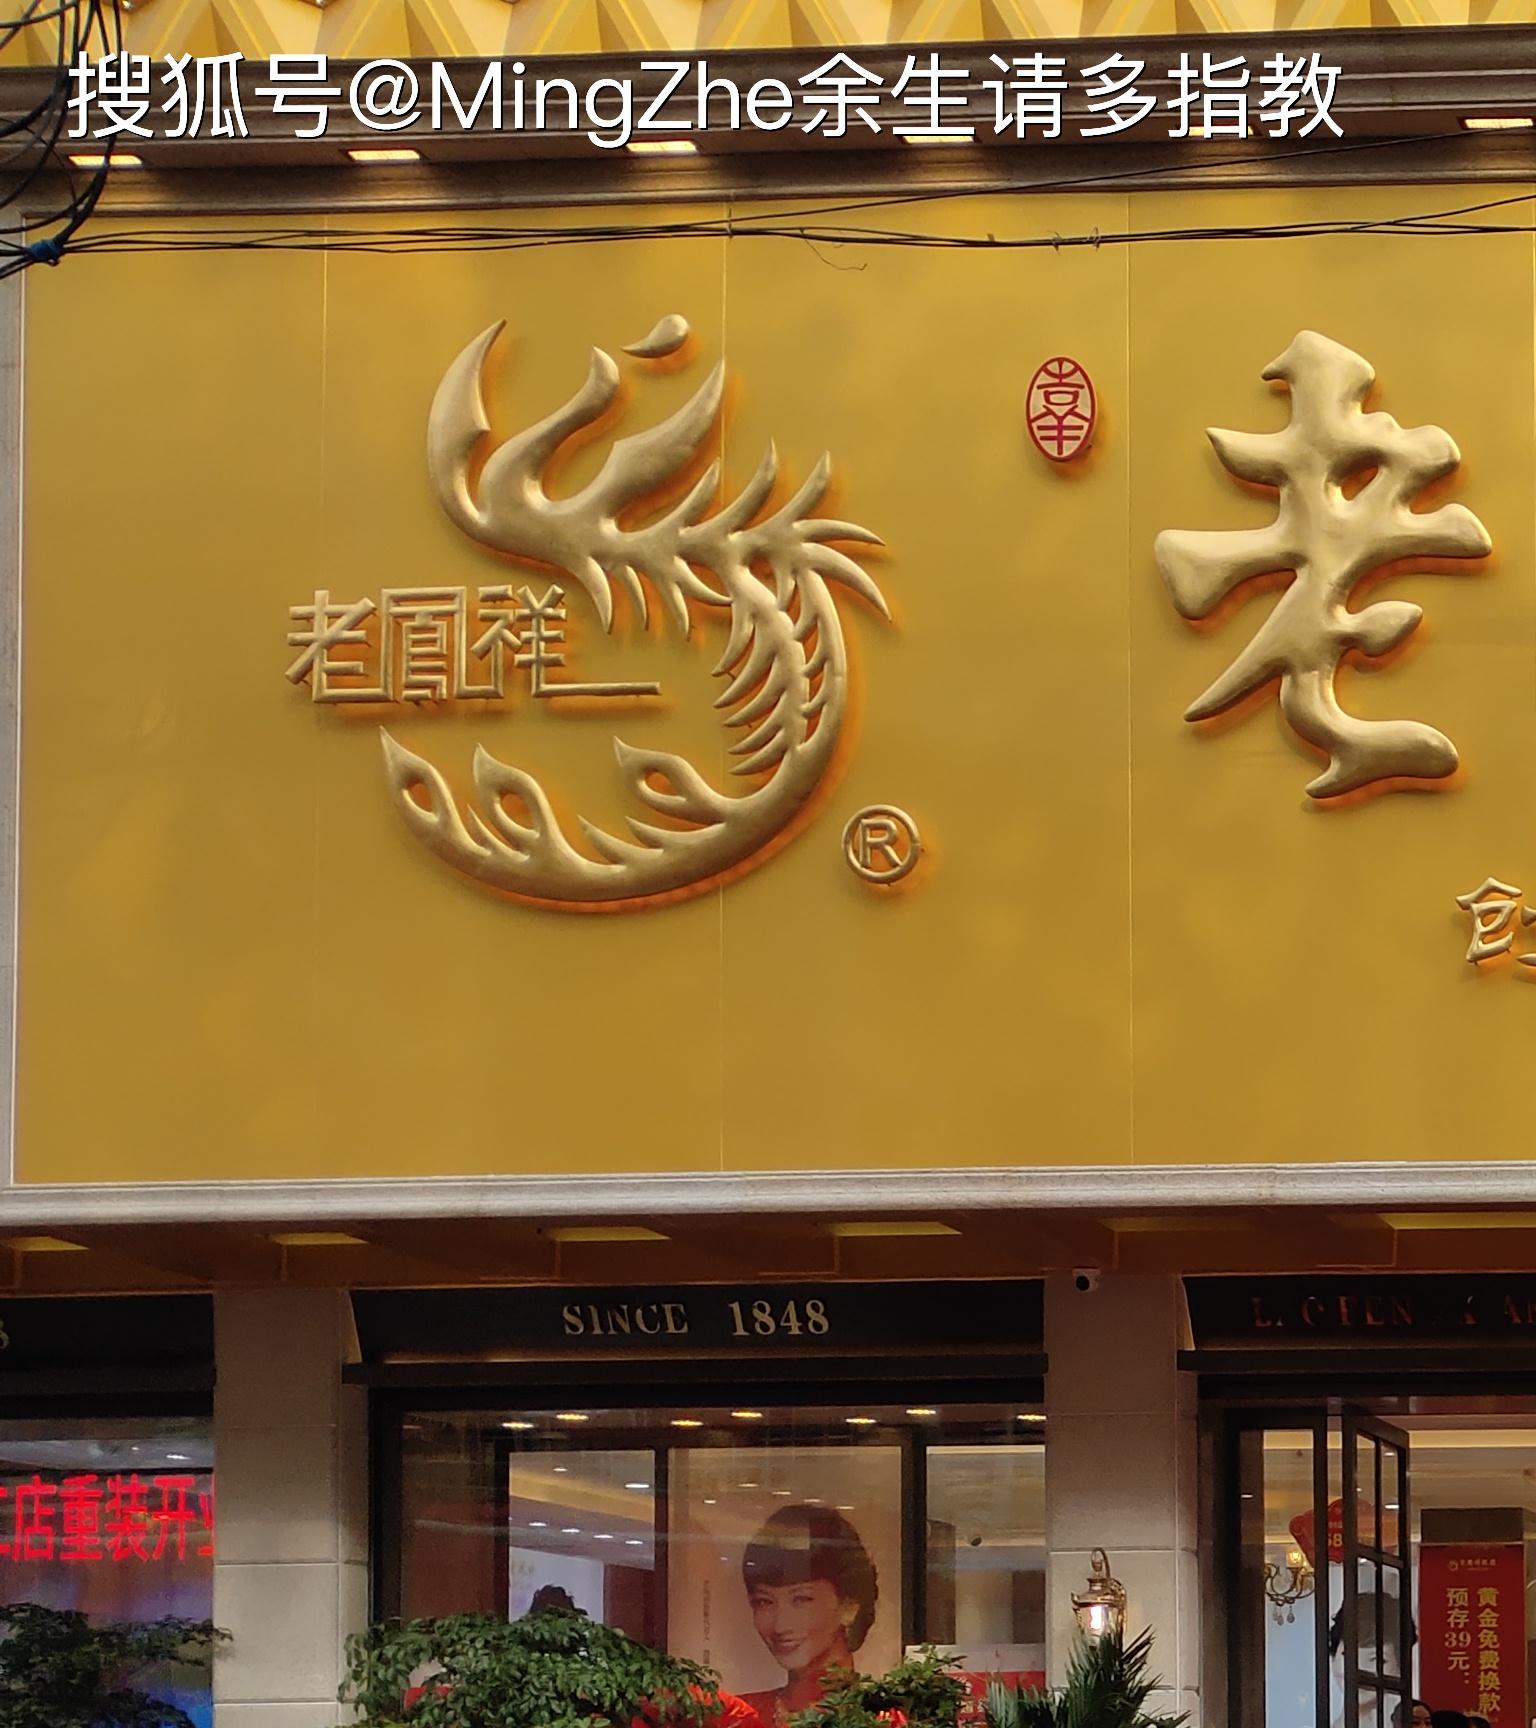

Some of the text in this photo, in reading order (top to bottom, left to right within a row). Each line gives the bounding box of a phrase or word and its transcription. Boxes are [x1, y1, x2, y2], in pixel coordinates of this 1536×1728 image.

[561, 1299, 830, 1336] SINCE 1848
[1477, 1586, 1502, 1713] 黄金免费换款
